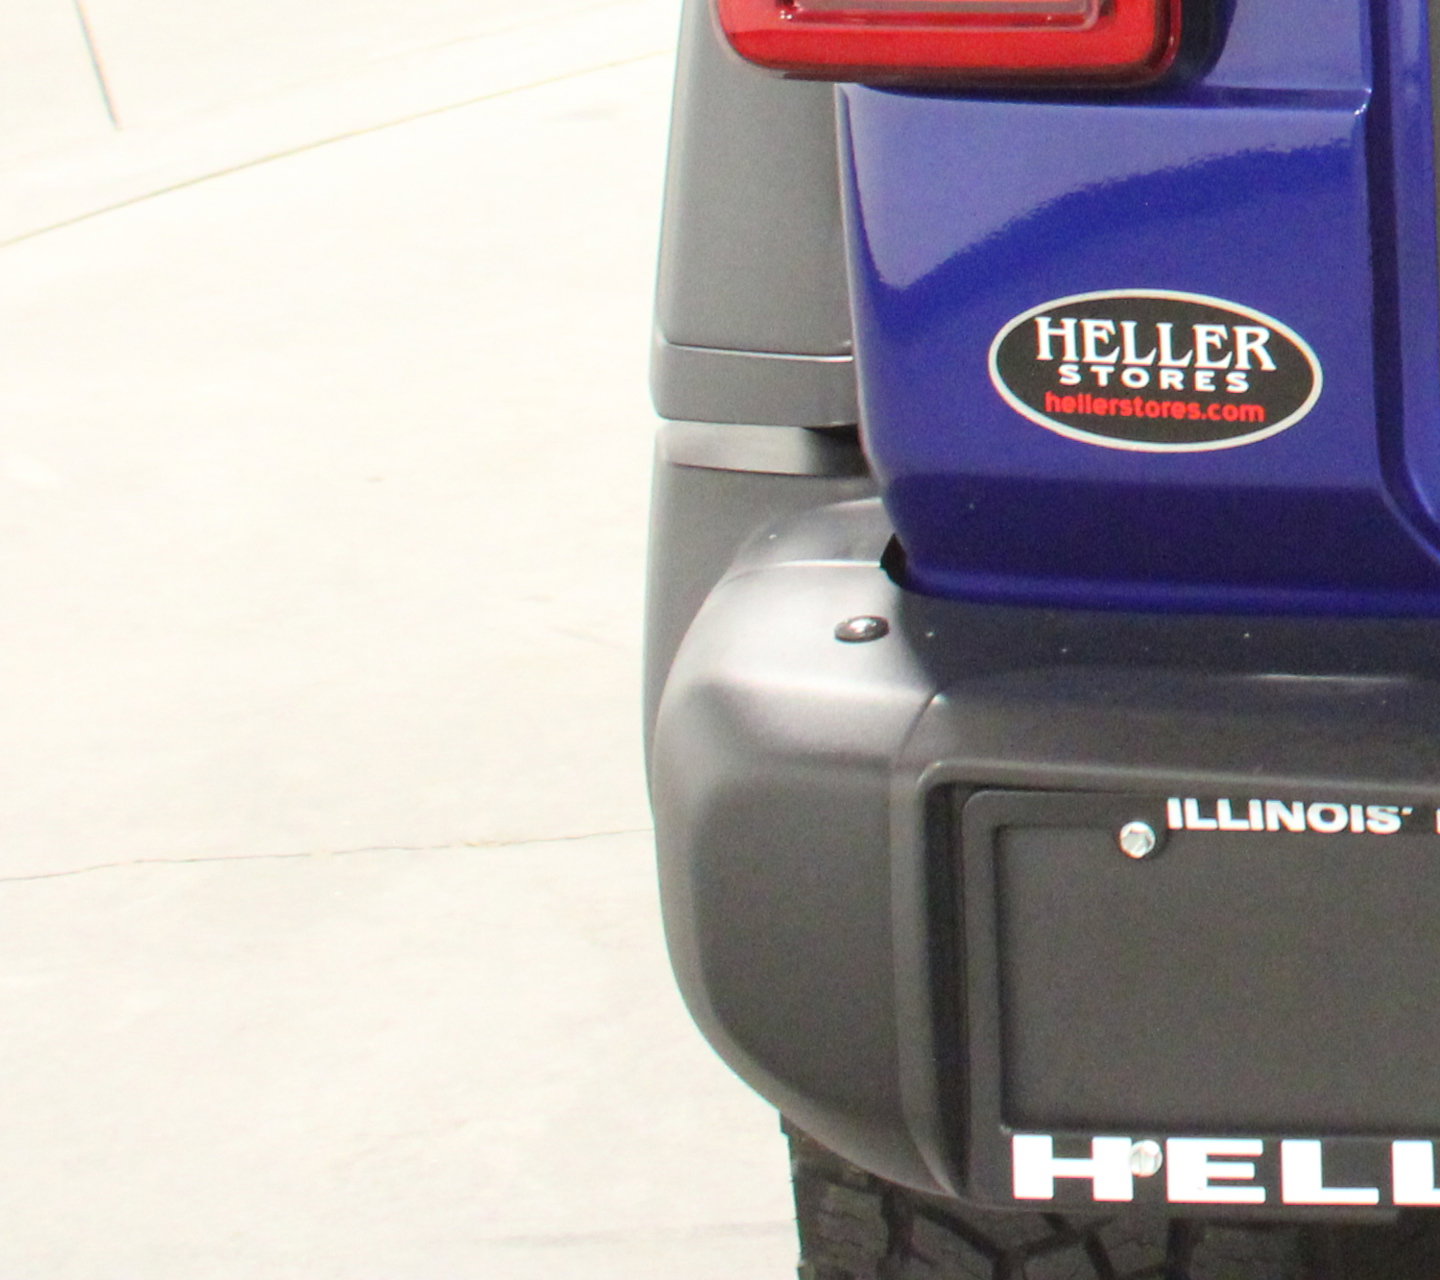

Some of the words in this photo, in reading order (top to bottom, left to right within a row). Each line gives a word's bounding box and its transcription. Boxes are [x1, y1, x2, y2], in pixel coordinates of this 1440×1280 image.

[1034, 316, 1277, 371] HELLER
[1058, 364, 1250, 393] STORES
[1044, 390, 1266, 423] hellerstores.com
